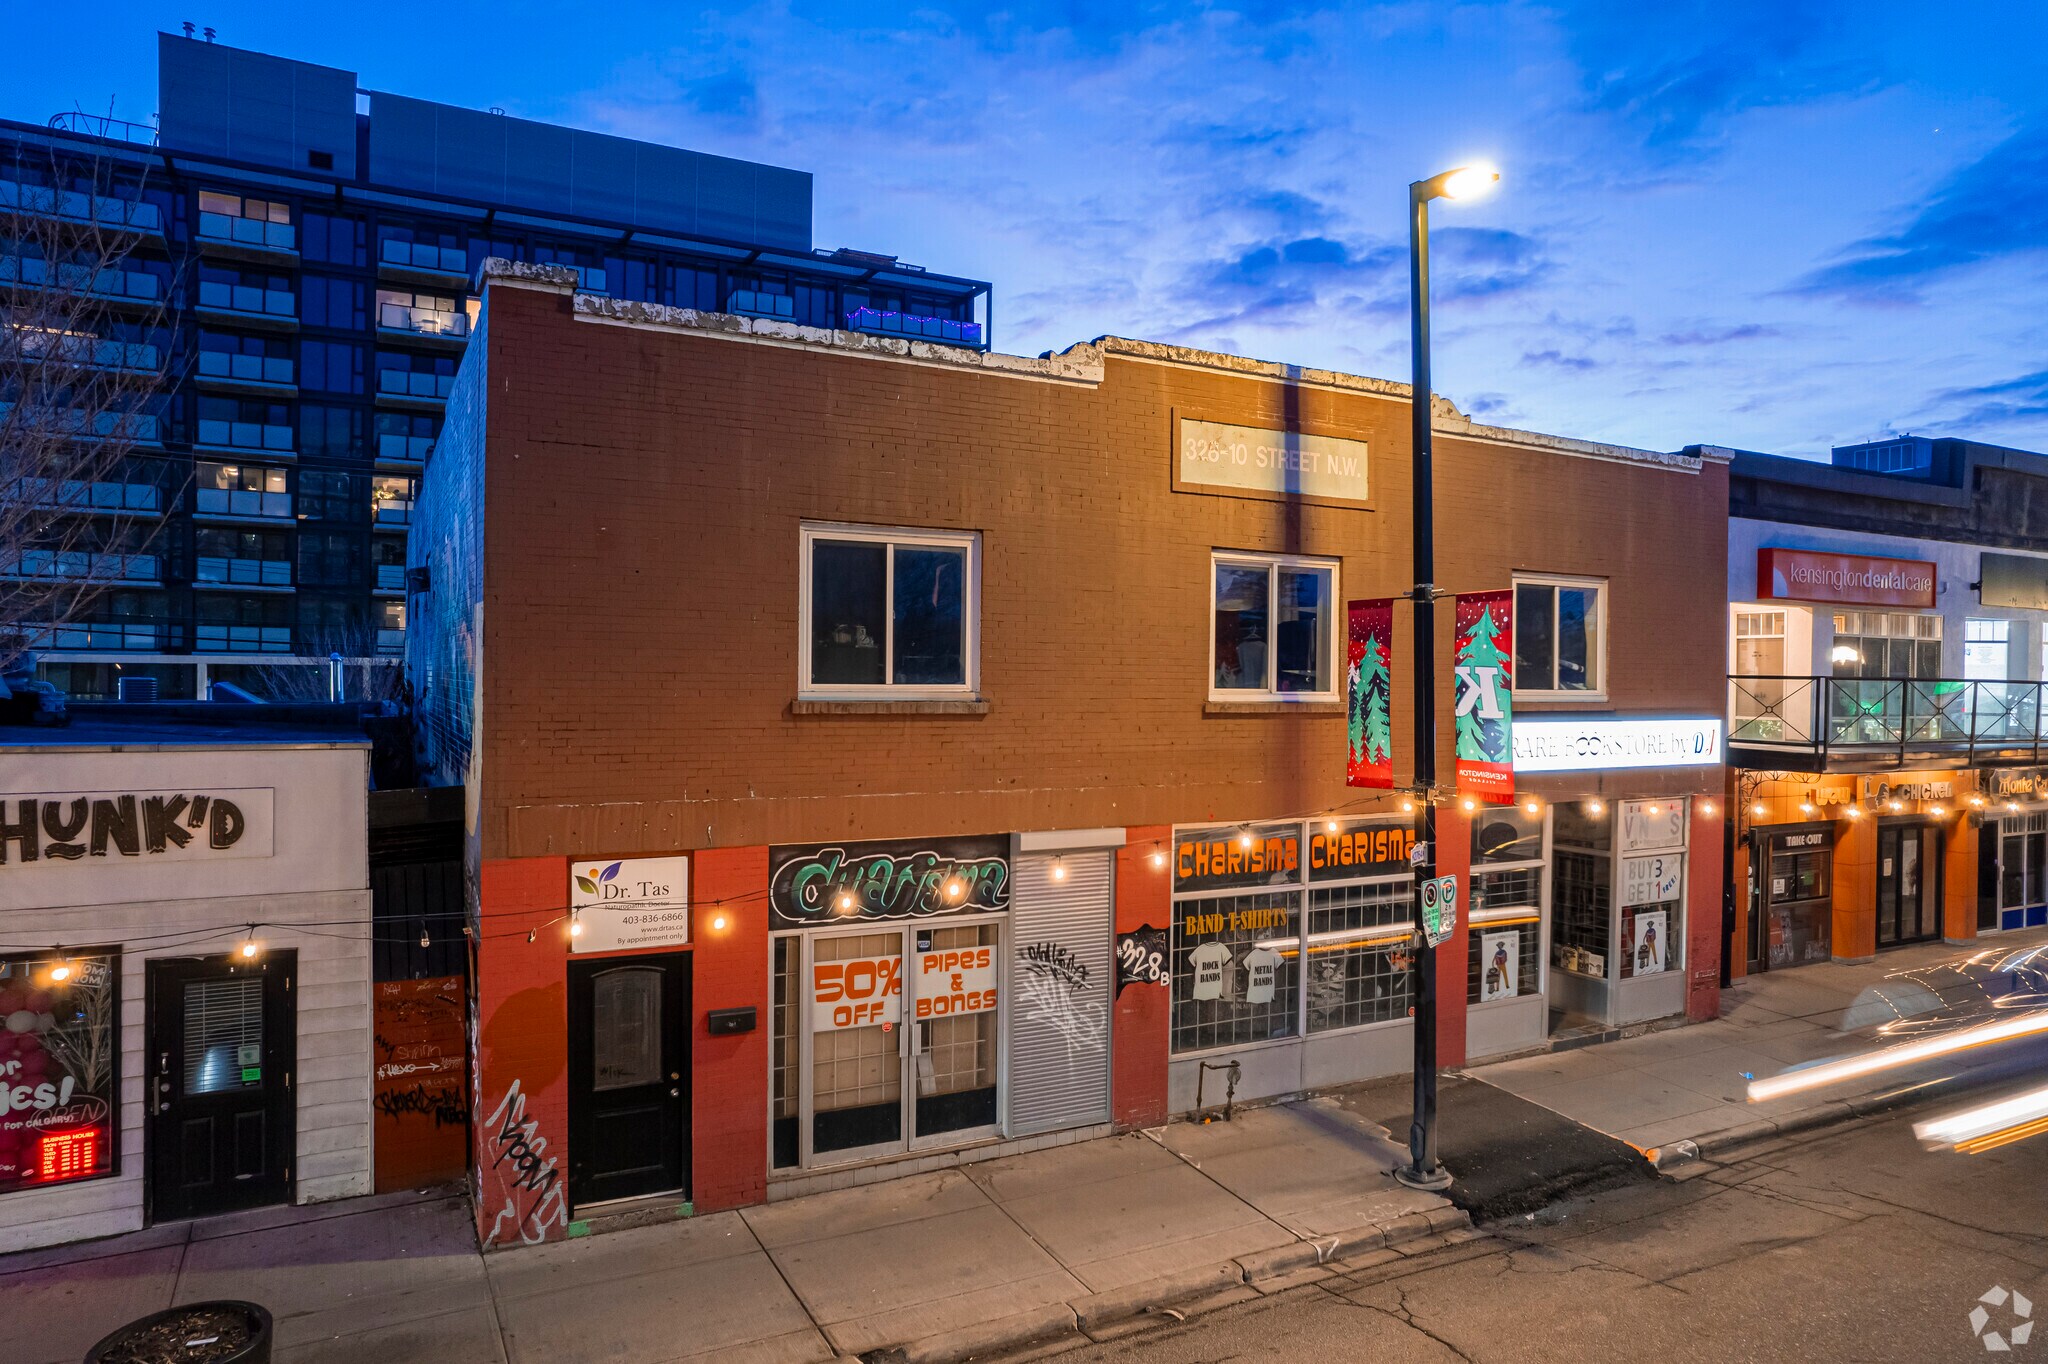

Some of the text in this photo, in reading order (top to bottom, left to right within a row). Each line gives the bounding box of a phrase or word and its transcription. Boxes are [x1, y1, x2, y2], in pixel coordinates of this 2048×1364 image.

[1255, 445, 1321, 473] STREET
[1327, 454, 1362, 478] N.W.
[1790, 562, 1932, 592] kensingtondentalcare
[1785, 833, 1823, 847] TAKE OUT
[1629, 860, 1654, 880] BUY
[1655, 858, 1663, 878] 3
[603, 881, 670, 900] Dr. Tas
[1628, 881, 1653, 902] GET
[1655, 880, 1662, 900] 1
[622, 912, 684, 925] 403-836-6866
[1185, 907, 1288, 937] BAND T-SHIRTS
[641, 925, 684, 933] www.drtas.ca
[617, 932, 684, 946] By appointment only
[917, 940, 931, 948] VISA
[1202, 960, 1220, 972] ROCK
[1254, 965, 1273, 976] METAL
[814, 957, 902, 1003] 50%
[950, 973, 964, 992] &
[1200, 972, 1221, 983] BANDS
[1253, 976, 1273, 987] BANDS
[834, 1001, 885, 1027] OFF
[4, 1122, 23, 1130] for
[43, 1134, 71, 1144] BUSINESS
[72, 1131, 95, 1140] HOURS
